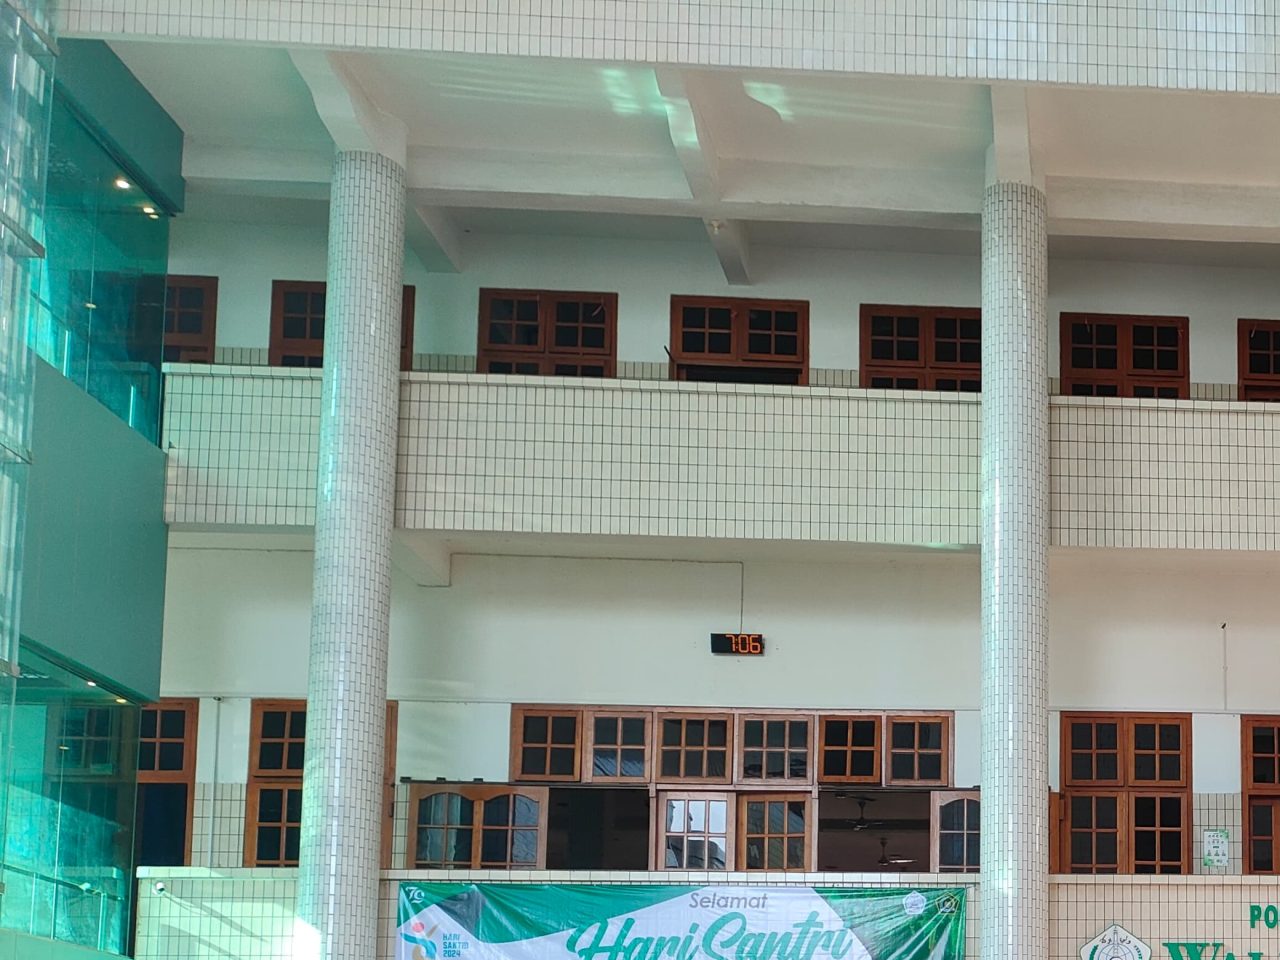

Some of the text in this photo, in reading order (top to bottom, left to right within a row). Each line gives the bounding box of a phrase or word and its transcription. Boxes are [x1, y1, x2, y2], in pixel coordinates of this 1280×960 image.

[725, 634, 761, 653] 7:06
[689, 891, 768, 910] Selamat
[442, 950, 461, 958] 2024
